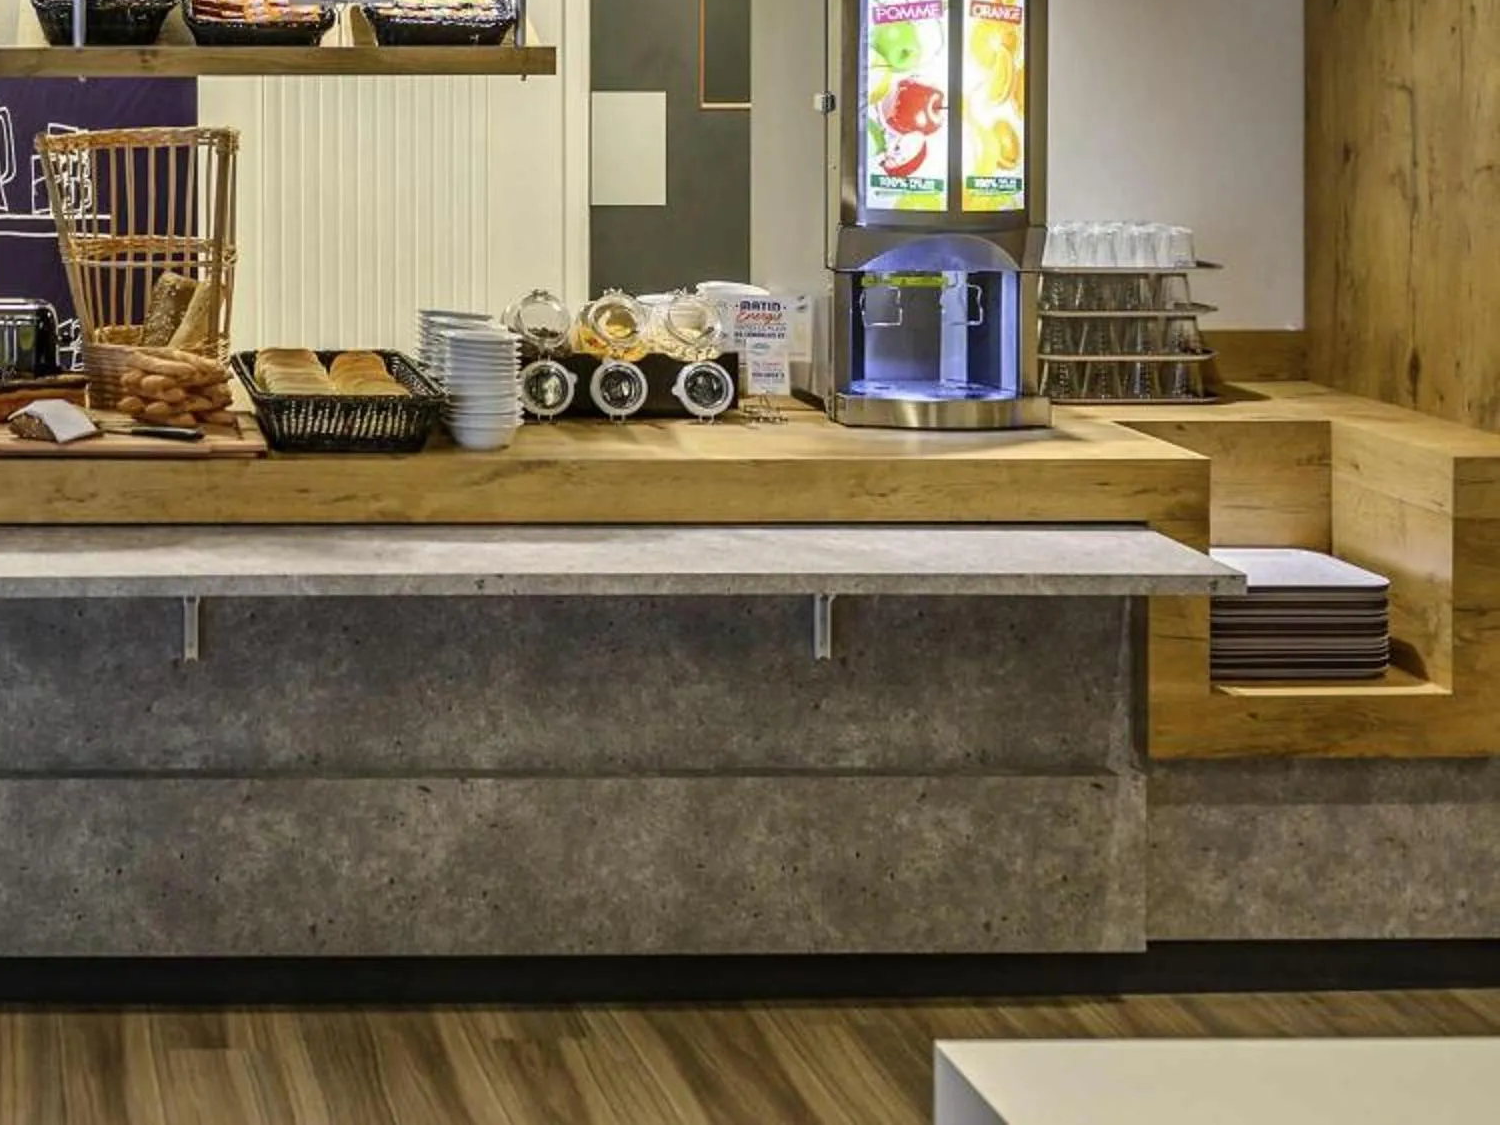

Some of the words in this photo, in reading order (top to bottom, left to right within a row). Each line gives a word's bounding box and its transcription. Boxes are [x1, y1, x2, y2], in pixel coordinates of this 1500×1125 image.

[875, 2, 941, 20] POMME
[972, 4, 1021, 21] ORANGE
[739, 300, 781, 311] MATIN
